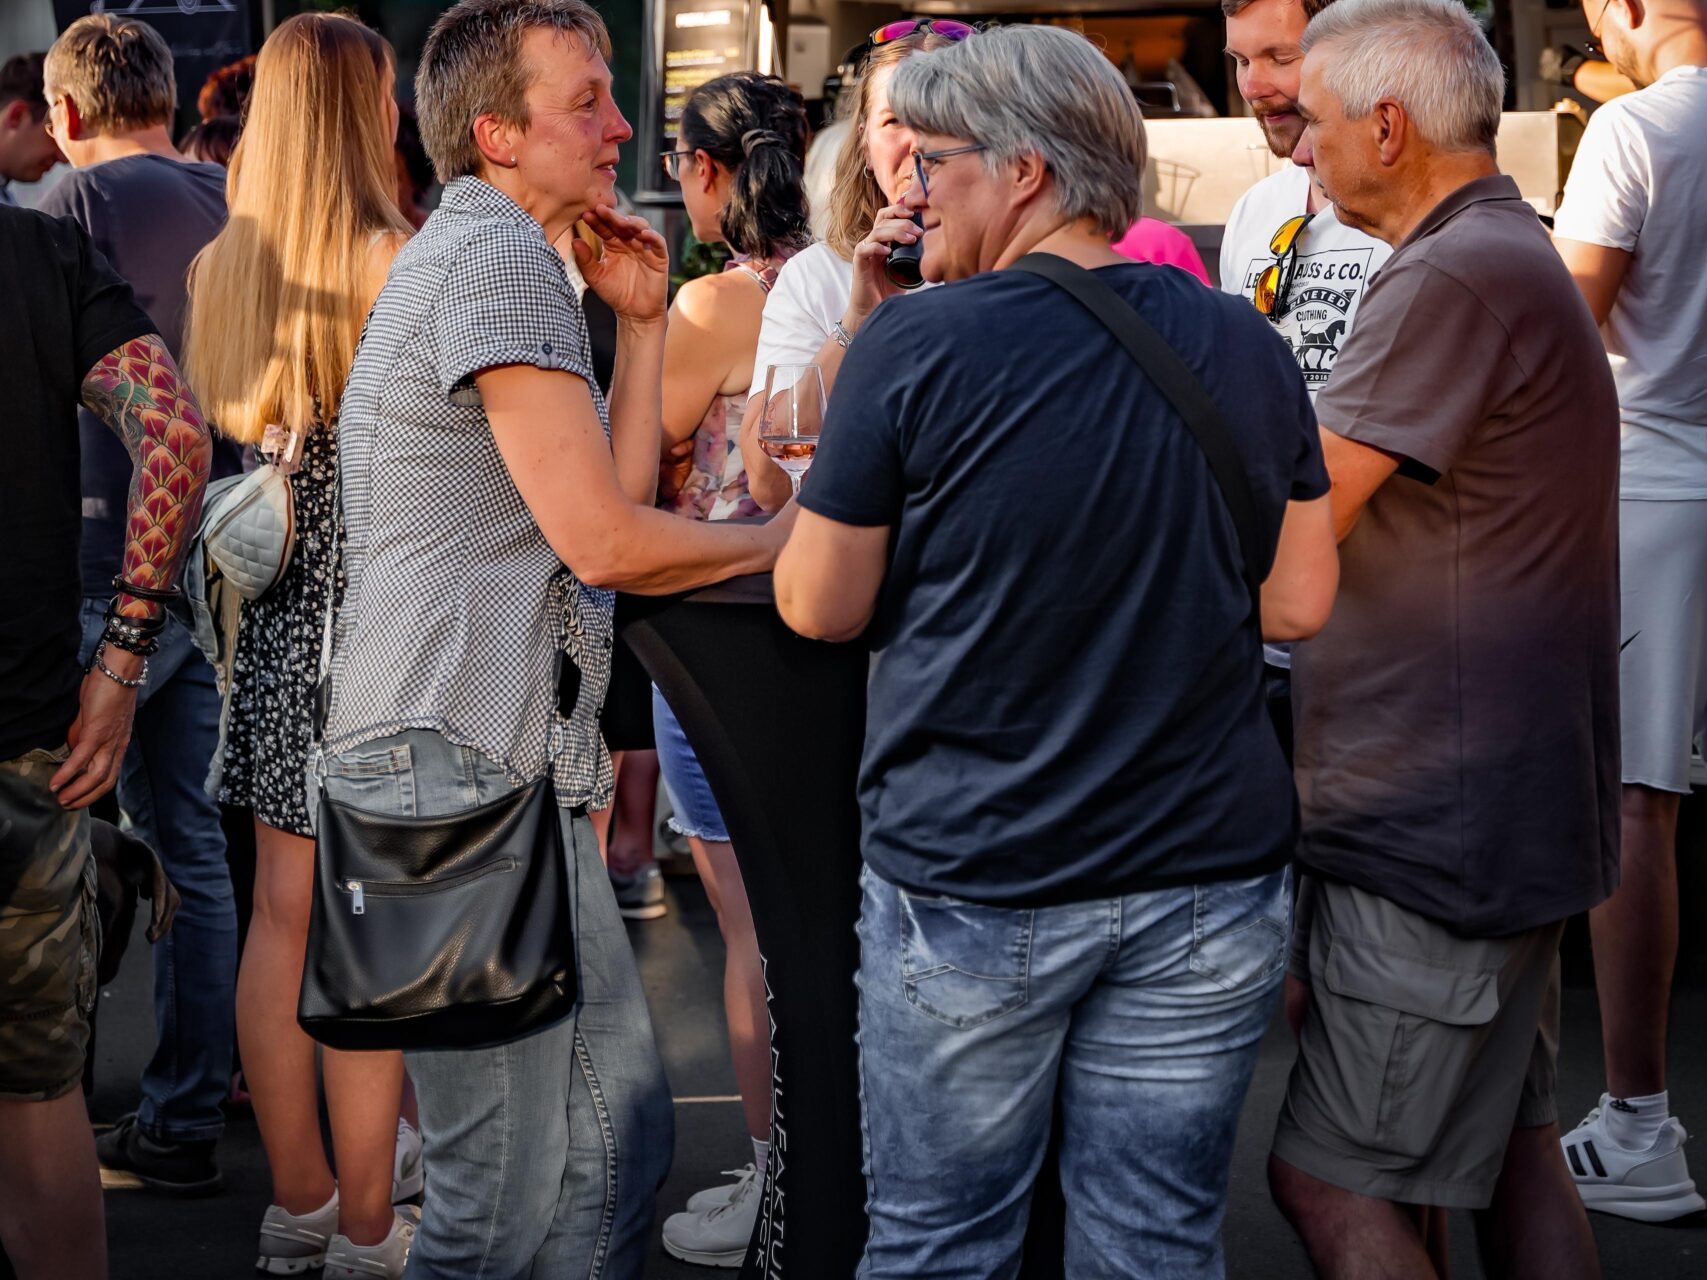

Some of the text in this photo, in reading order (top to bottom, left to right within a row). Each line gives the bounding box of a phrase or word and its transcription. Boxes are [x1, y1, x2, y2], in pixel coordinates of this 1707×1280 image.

[1323, 263, 1336, 280] &
[1338, 262, 1363, 280] CO.
[1290, 290, 1347, 310] RIVETED
[1296, 309, 1327, 322] CLOTHING
